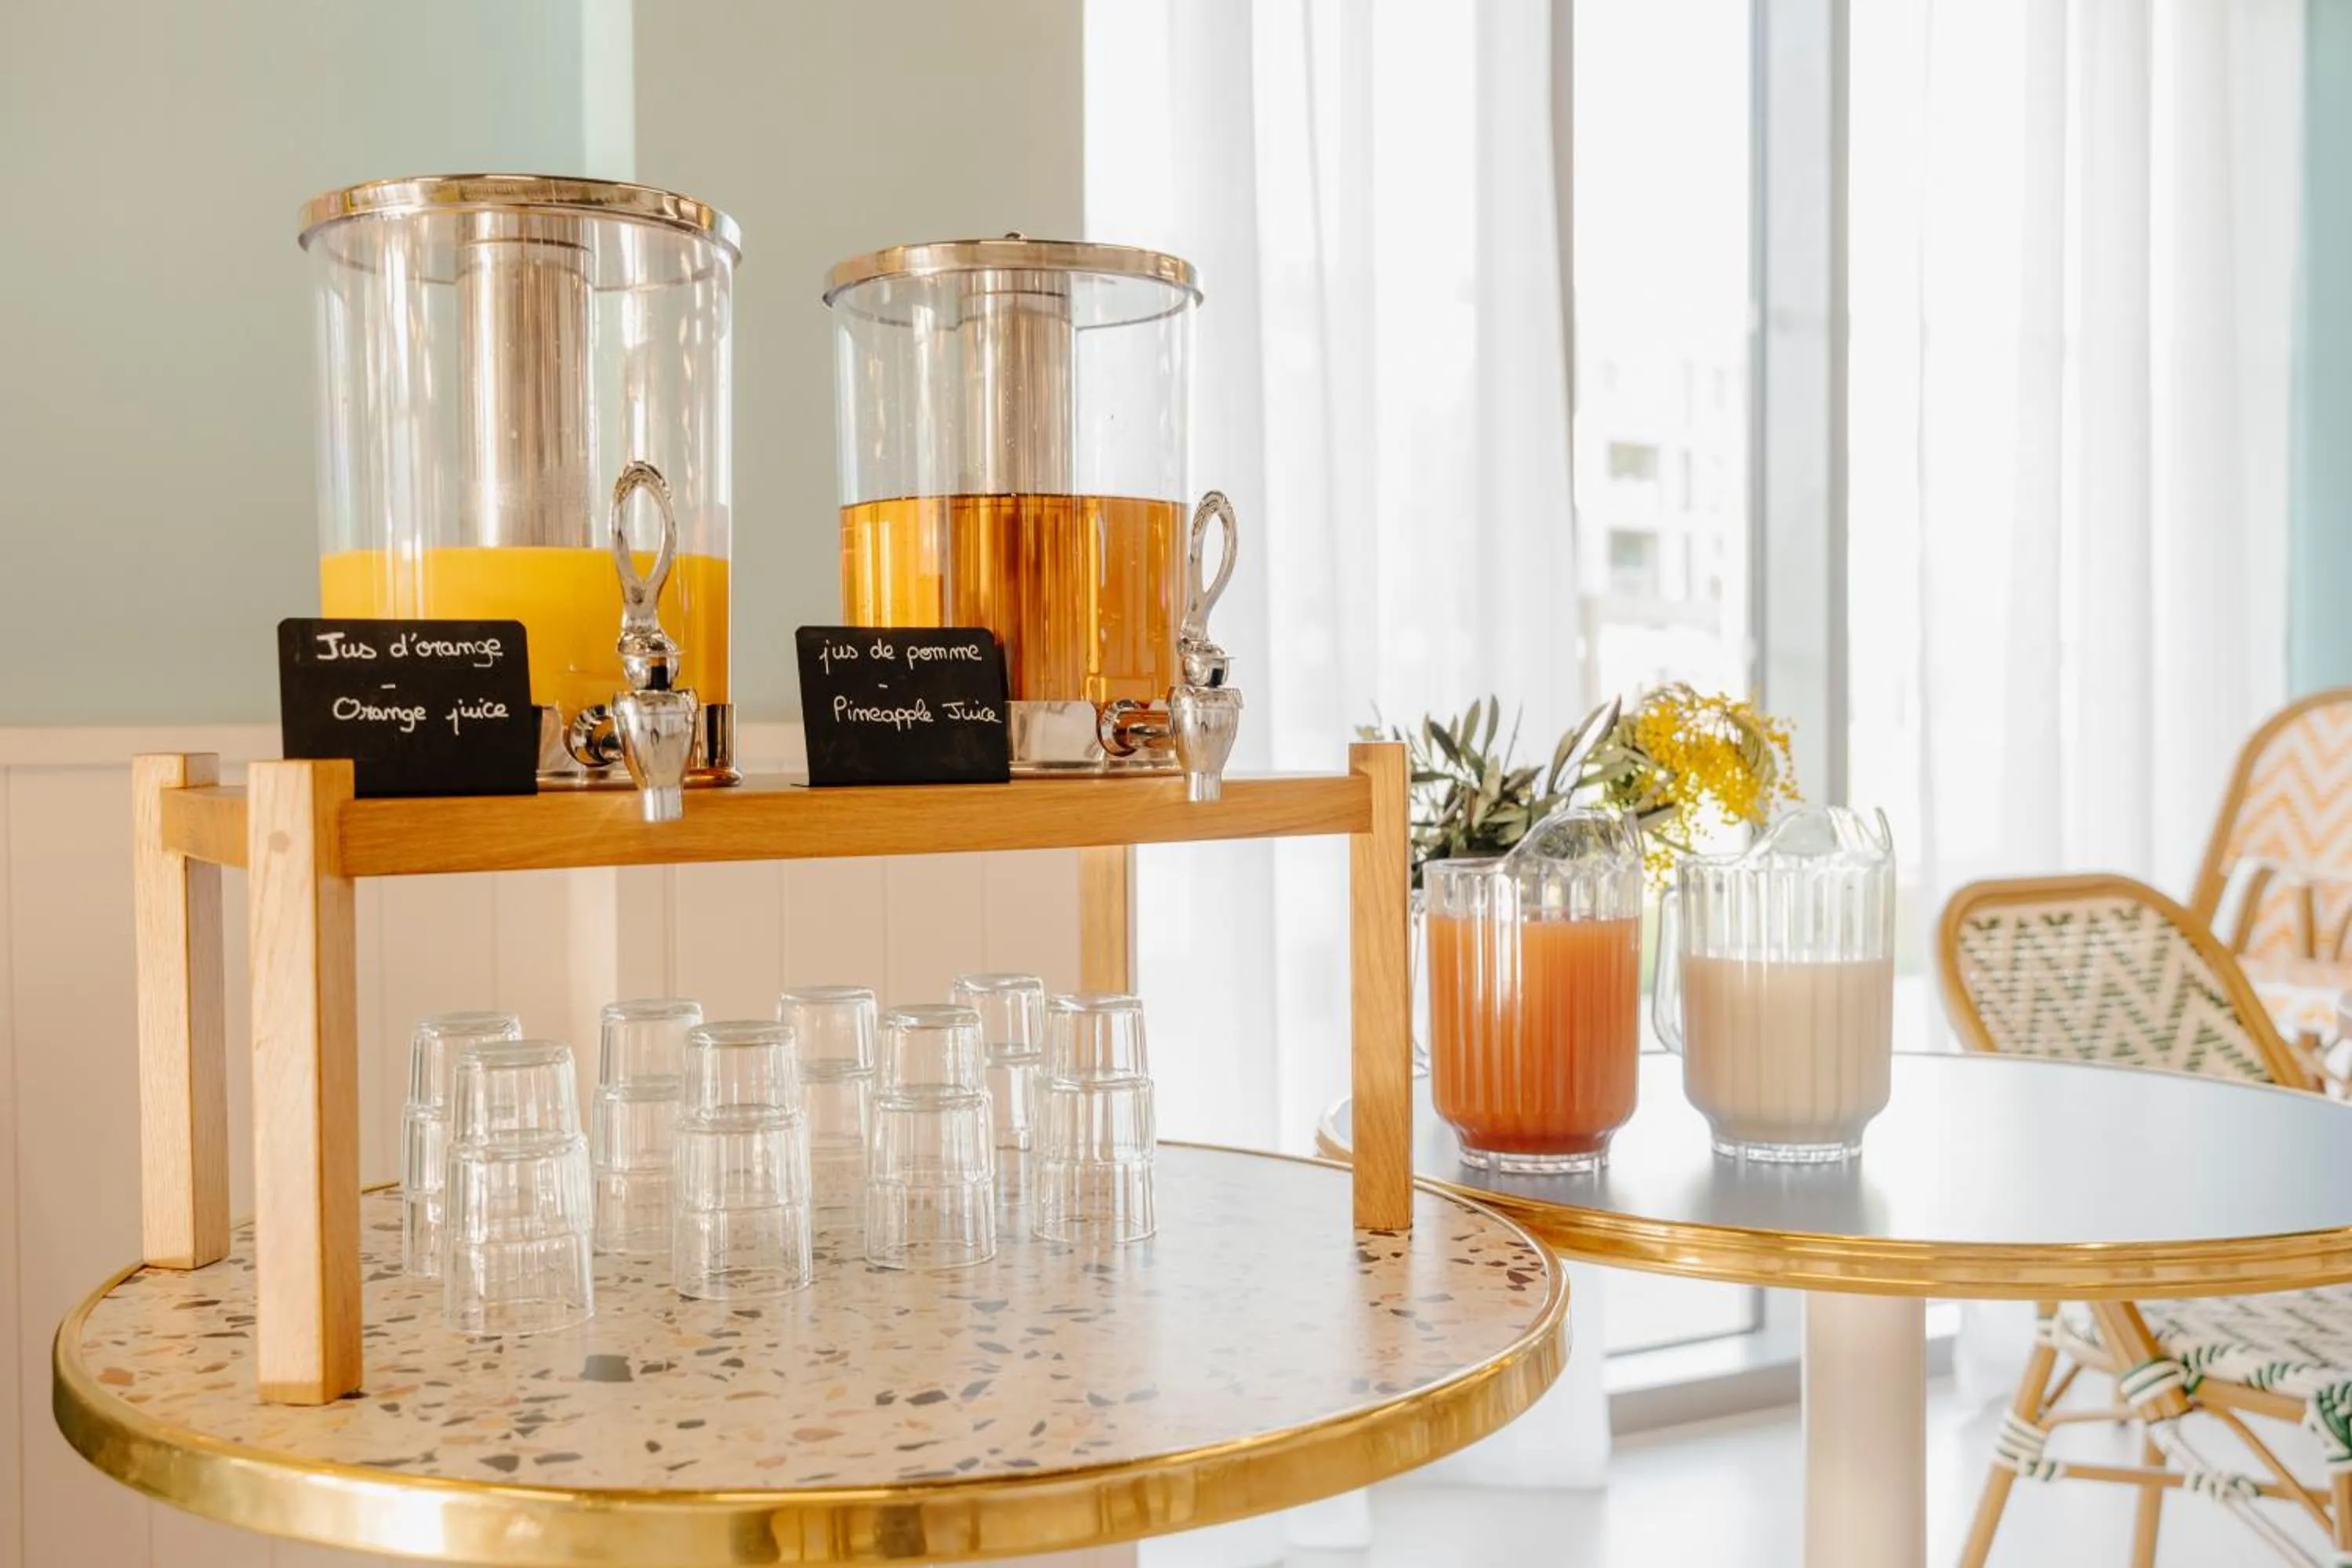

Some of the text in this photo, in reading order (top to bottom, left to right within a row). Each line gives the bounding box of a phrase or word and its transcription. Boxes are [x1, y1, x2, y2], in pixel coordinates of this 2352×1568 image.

[316, 631, 503, 668] Jus d'orange
[818, 637, 982, 674] jus de pomme
[332, 696, 509, 735] Orange juice
[833, 695, 1002, 731] Pineapple Juice
